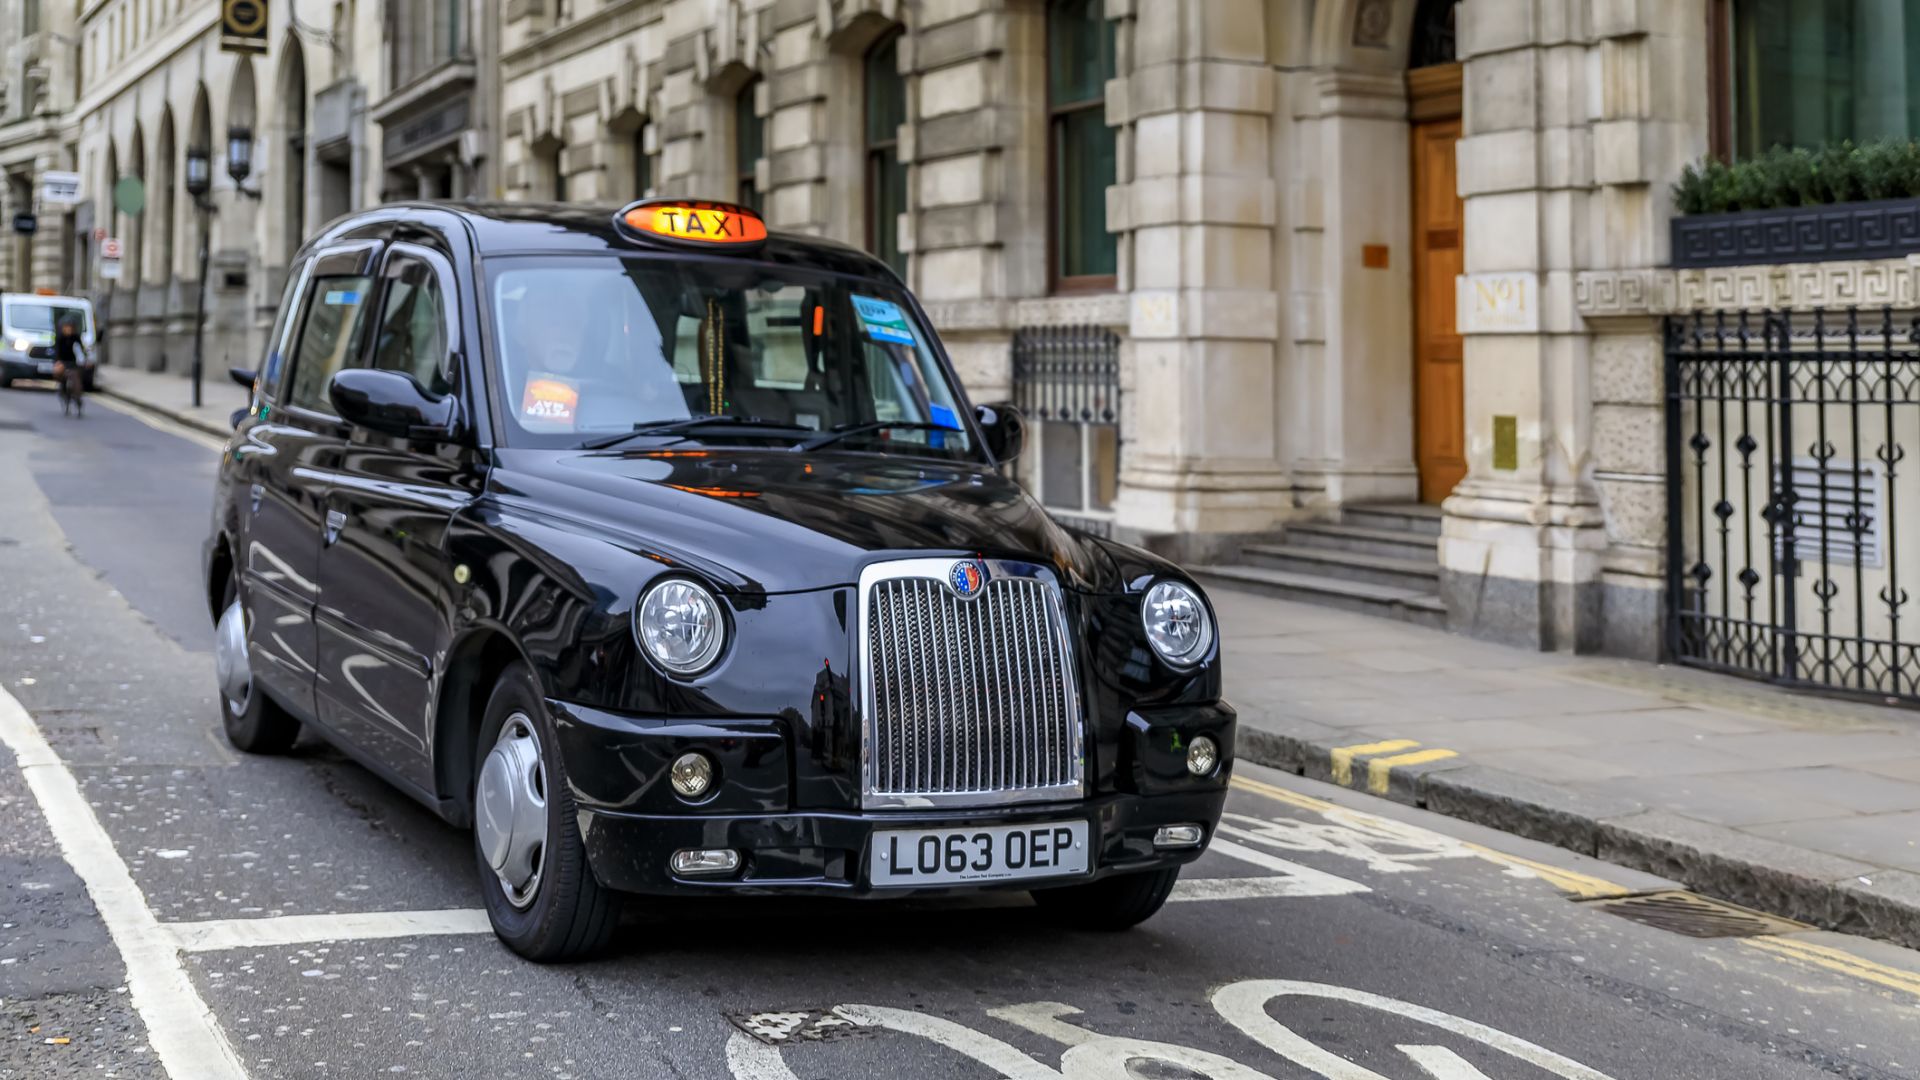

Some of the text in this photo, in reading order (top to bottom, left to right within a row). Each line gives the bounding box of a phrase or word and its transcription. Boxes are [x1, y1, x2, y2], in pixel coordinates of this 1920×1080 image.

[662, 211, 744, 237] TAXI
[889, 827, 1073, 876] LO63 OEP
